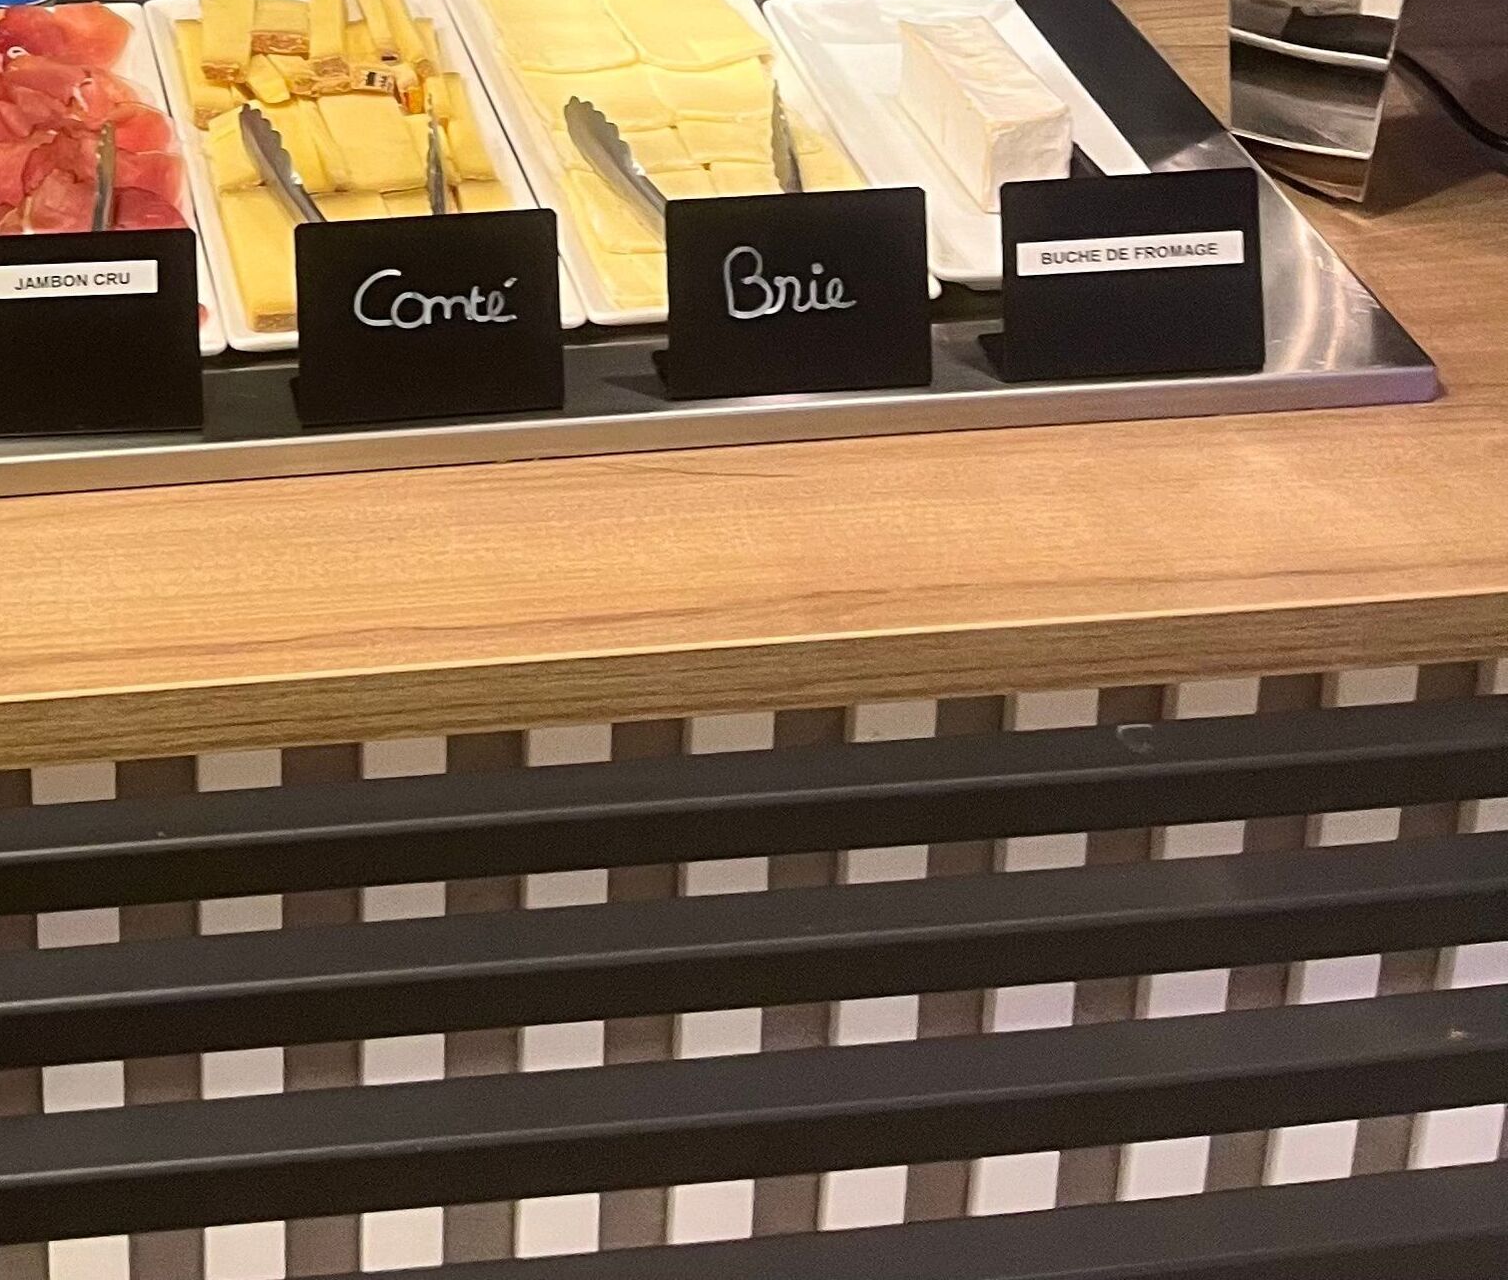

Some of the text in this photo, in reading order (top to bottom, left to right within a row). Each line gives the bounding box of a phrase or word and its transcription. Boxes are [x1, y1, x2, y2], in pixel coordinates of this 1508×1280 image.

[1041, 242, 1220, 265] BUCHE DE FROMAGE
[14, 272, 131, 291] JAMBON CRU
[353, 268, 519, 330] Comté
[723, 245, 858, 320] Brie
